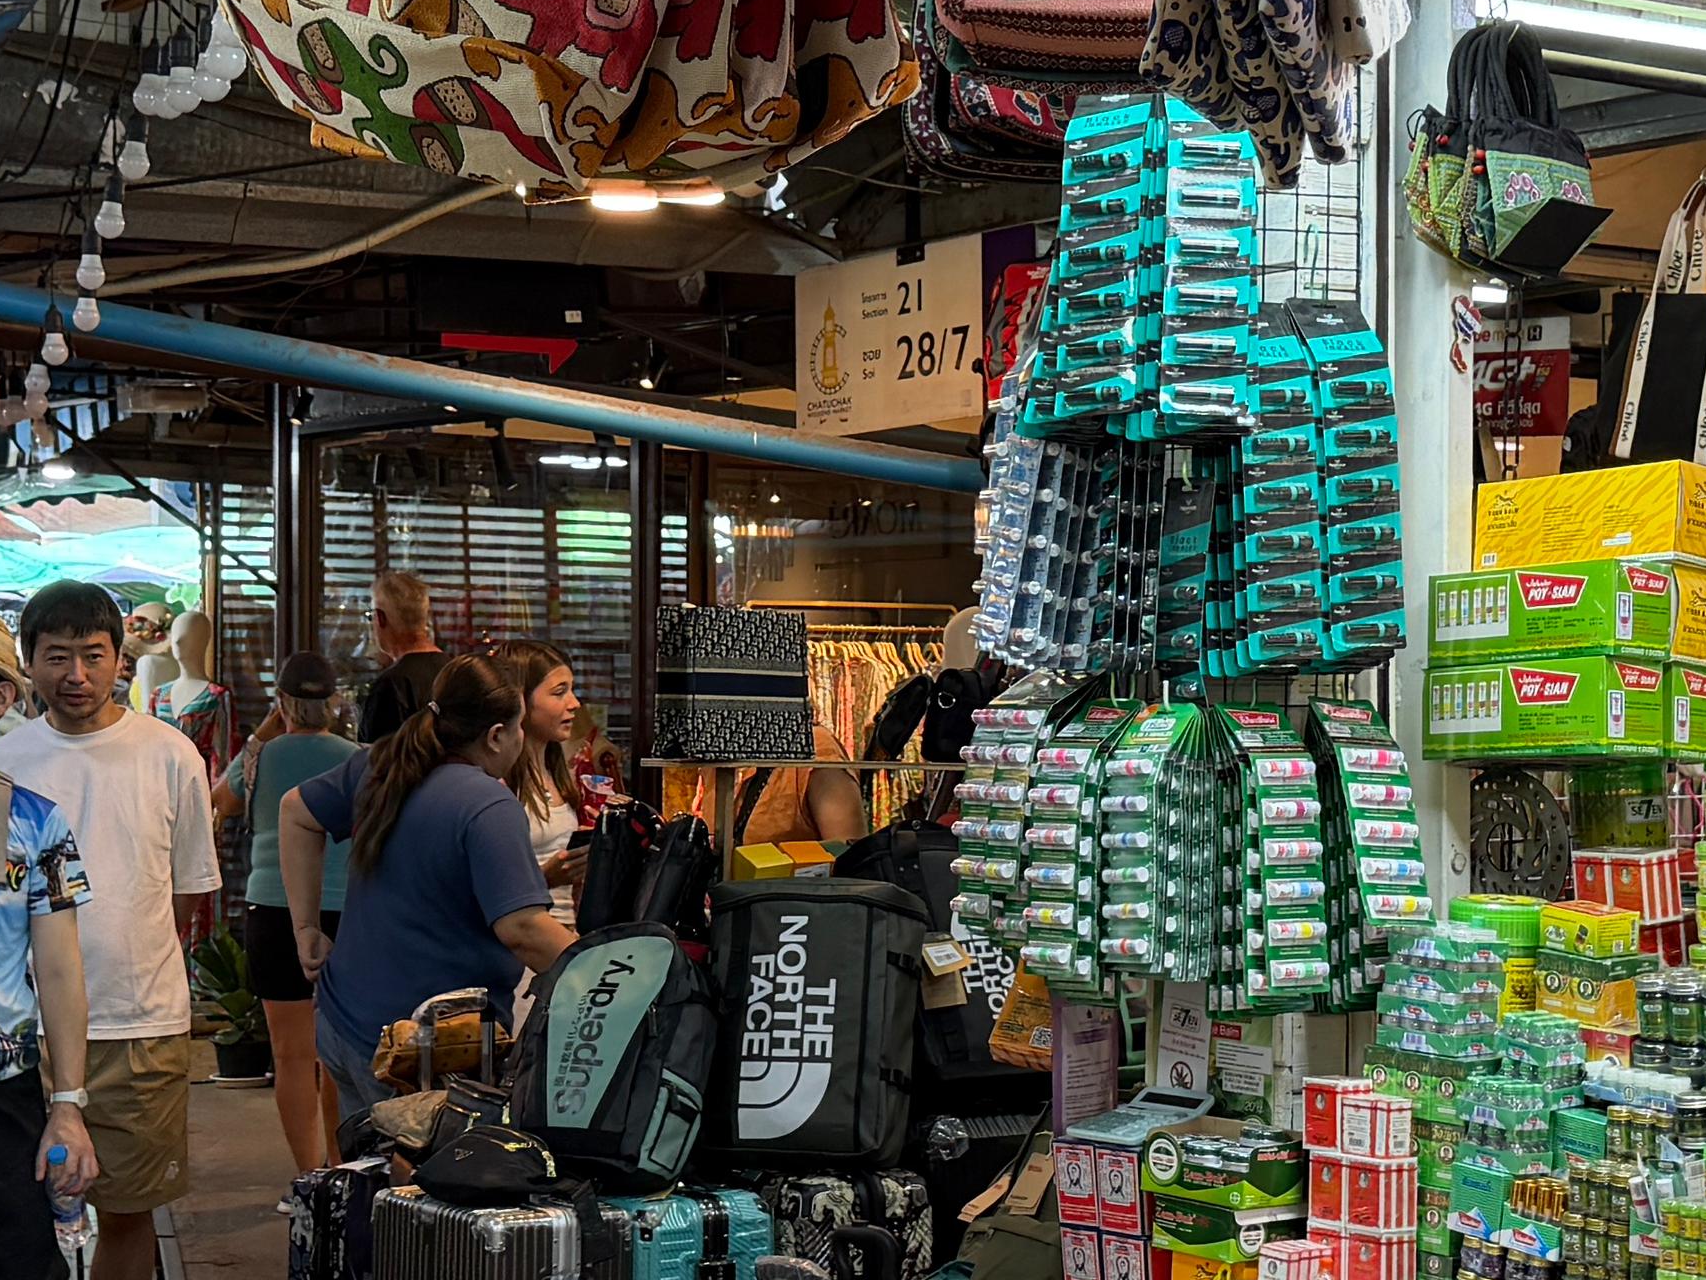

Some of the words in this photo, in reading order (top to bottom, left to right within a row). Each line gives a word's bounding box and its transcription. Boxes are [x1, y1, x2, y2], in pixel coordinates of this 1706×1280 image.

[862, 308, 888, 319] Section
[897, 279, 922, 315] 21
[863, 369, 875, 380] Soi
[897, 325, 970, 380] 28/7
[807, 397, 852, 412] CHATUCHAK
[771, 915, 809, 1058] NORTH
[961, 940, 985, 995] THE
[742, 954, 775, 1056] FACE
[802, 978, 837, 1058] THE
